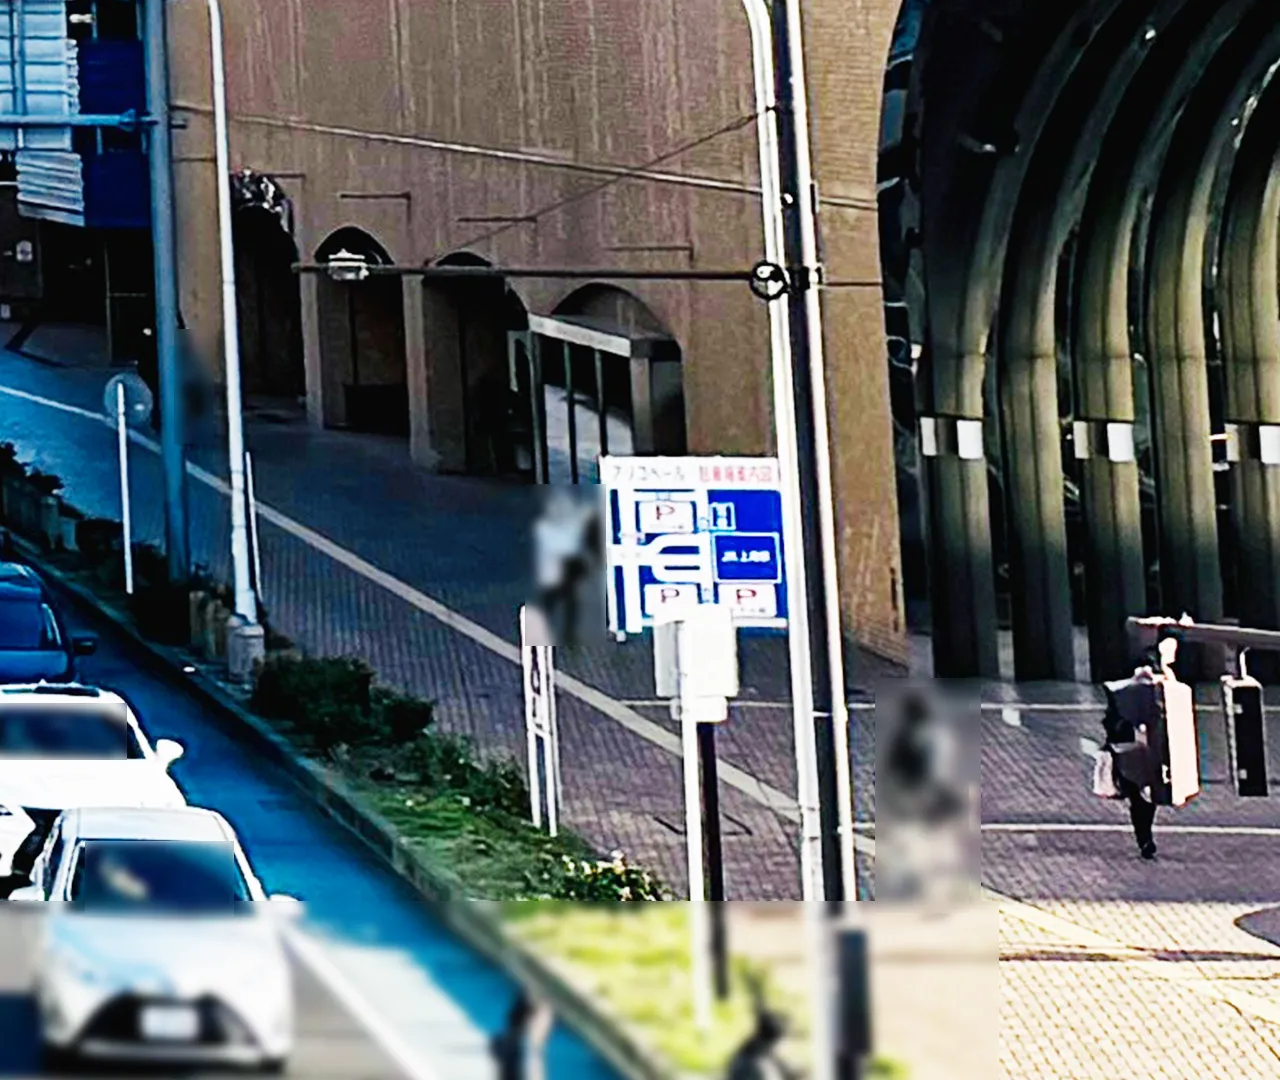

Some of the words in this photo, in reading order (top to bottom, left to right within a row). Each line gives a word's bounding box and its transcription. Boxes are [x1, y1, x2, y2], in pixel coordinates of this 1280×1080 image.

[656, 504, 675, 520] P
[660, 588, 680, 603] P
[736, 588, 757, 604] P
